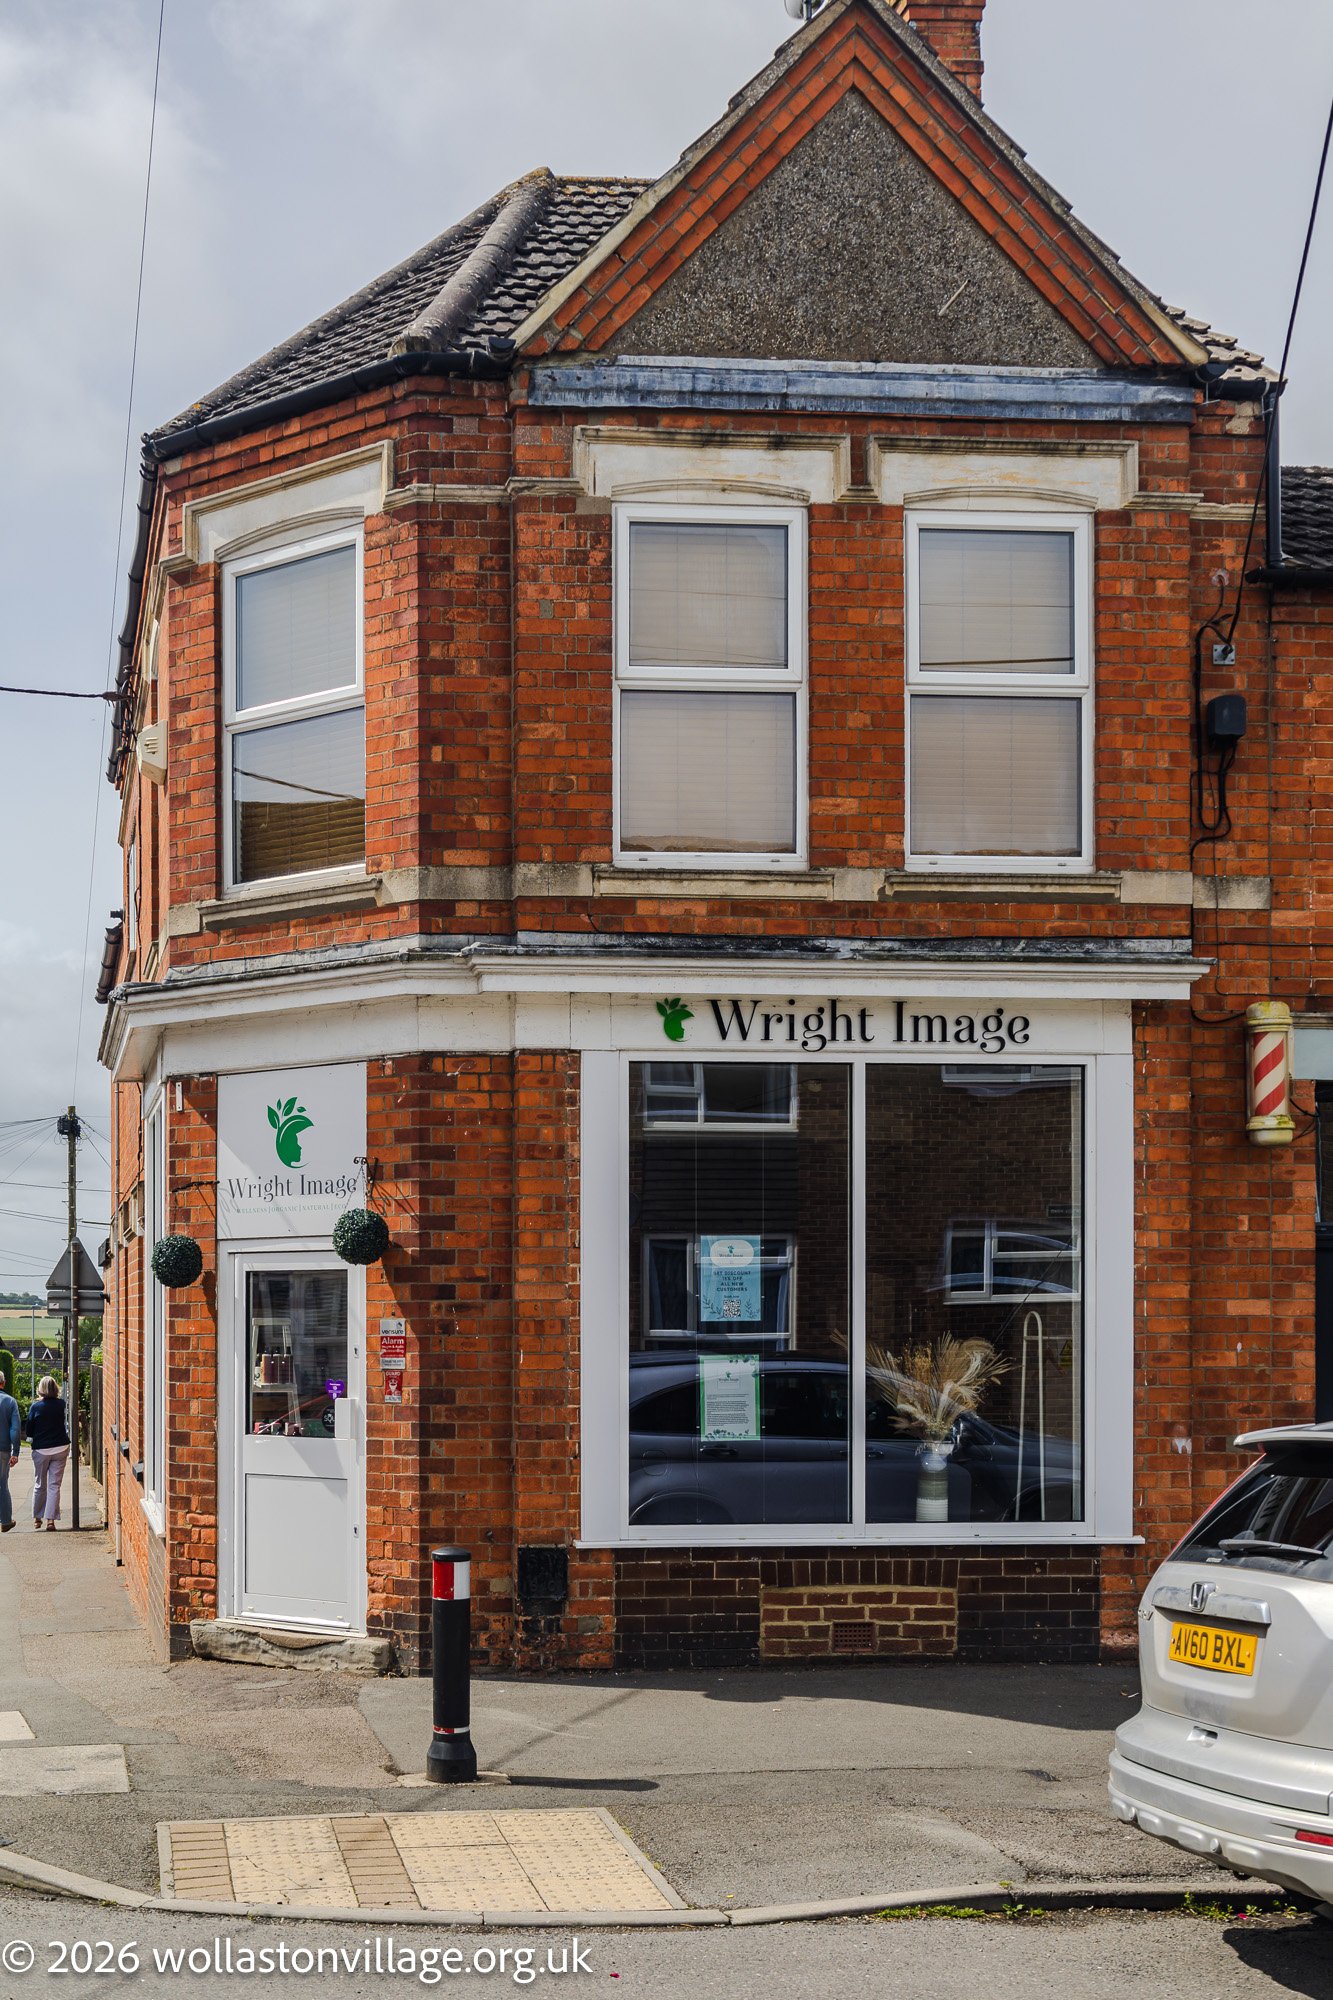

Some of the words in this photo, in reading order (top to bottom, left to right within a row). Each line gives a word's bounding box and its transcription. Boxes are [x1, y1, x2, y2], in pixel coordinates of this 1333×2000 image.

[706, 998, 875, 1053] Wright
[892, 1000, 1031, 1054] Image
[227, 1175, 293, 1203] Wright
[300, 1174, 357, 1199] Image
[381, 1336, 404, 1345] Alarm
[1174, 1627, 1209, 1661] AV60
[1212, 1634, 1246, 1669] BXL
